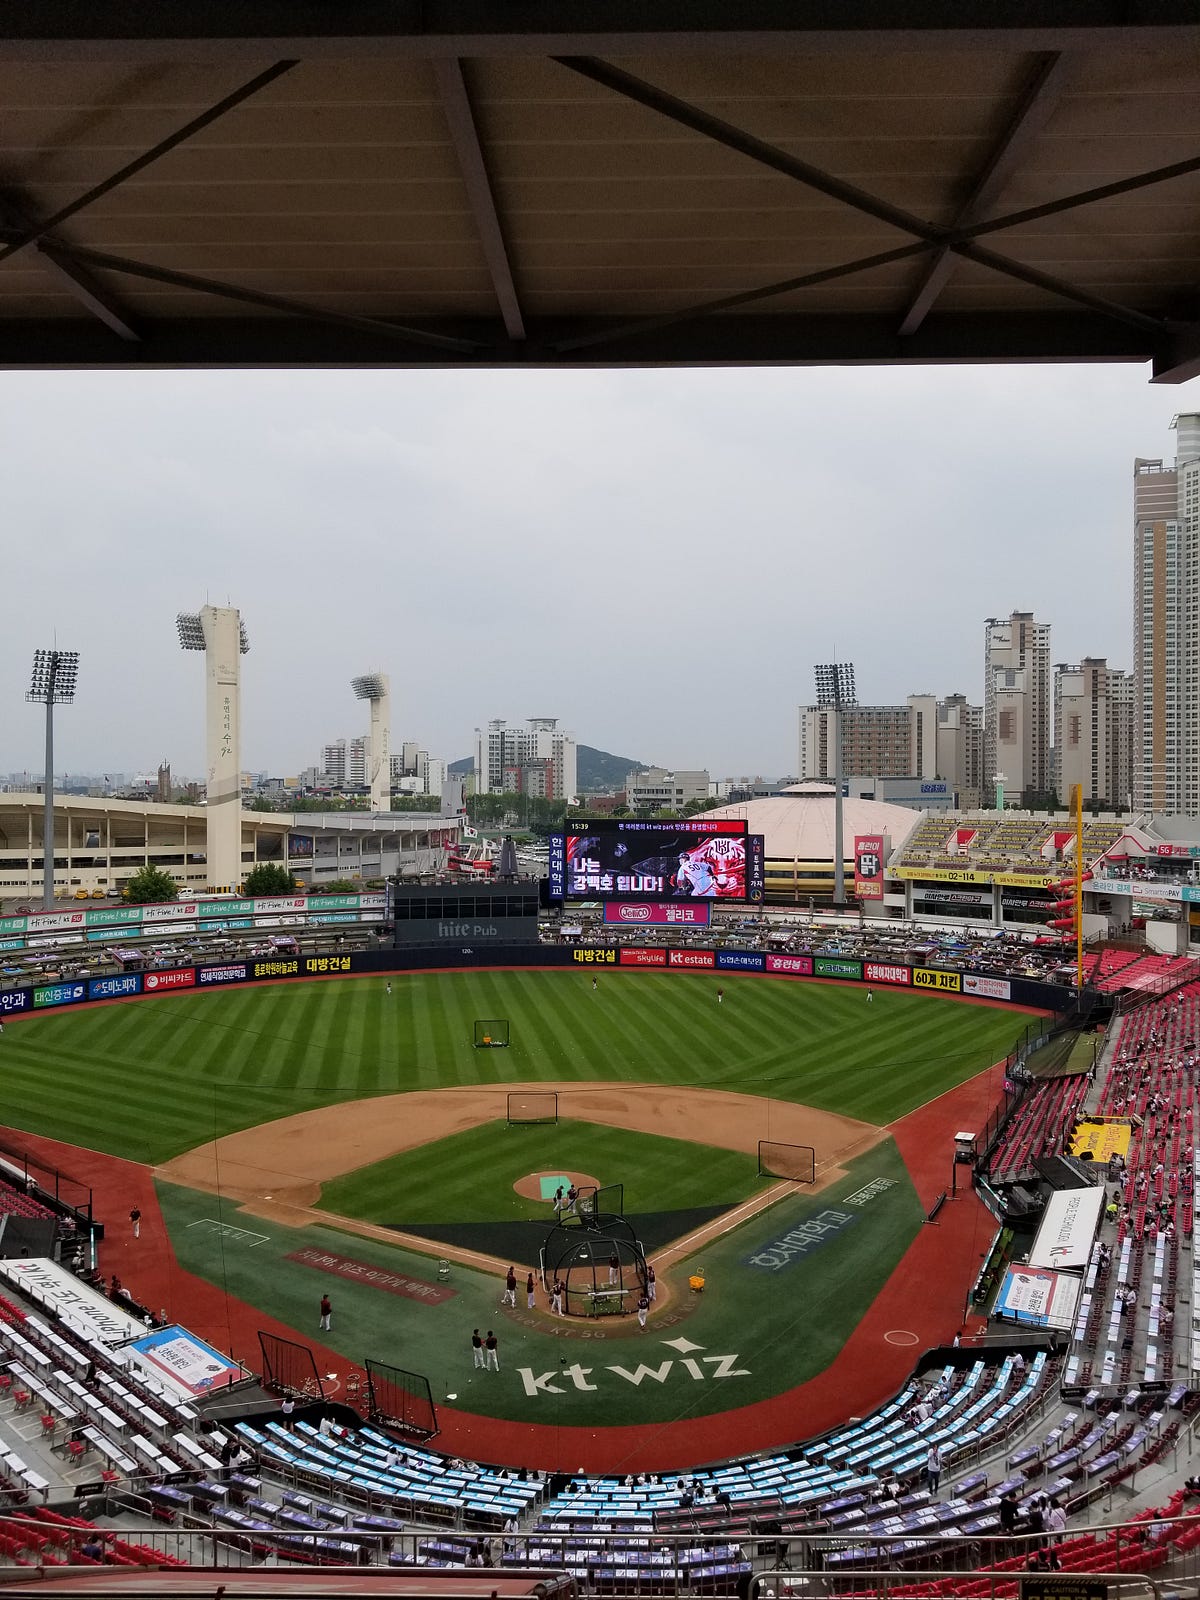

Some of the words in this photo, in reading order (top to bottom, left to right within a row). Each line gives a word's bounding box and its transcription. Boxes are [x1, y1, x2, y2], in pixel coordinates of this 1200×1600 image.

[552, 837, 562, 895] 한세대학교
[573, 858, 600, 872] 나는
[573, 874, 613, 891] 강백호
[617, 876, 663, 892] 입니다!
[948, 872, 974, 880] 02-114
[1092, 882, 1114, 892] 온라인
[1144, 888, 1180, 897] SmartroPAY
[41, 916, 61, 925] Five!
[666, 909, 695, 921] 젤리코
[438, 922, 470, 937] hite
[473, 925, 497, 936] Pub
[573, 950, 615, 962] 대방건설
[671, 953, 682, 963] kt
[685, 956, 712, 964] estate
[254, 961, 298, 977] 종로학원하늘교육
[306, 956, 351, 972] 대방건설
[160, 972, 192, 984] 비씨카드
[867, 964, 908, 982] 수원여자대학교
[916, 972, 937, 985] 60계
[940, 975, 957, 988] 치킨
[101, 978, 136, 994] 도미노피자
[0, 993, 25, 1009] 안과
[35, 987, 72, 1002] 대신증권
[78, 1304, 126, 1338] iPhone
[515, 1363, 598, 1396] kt
[604, 1336, 752, 1386] wiz
